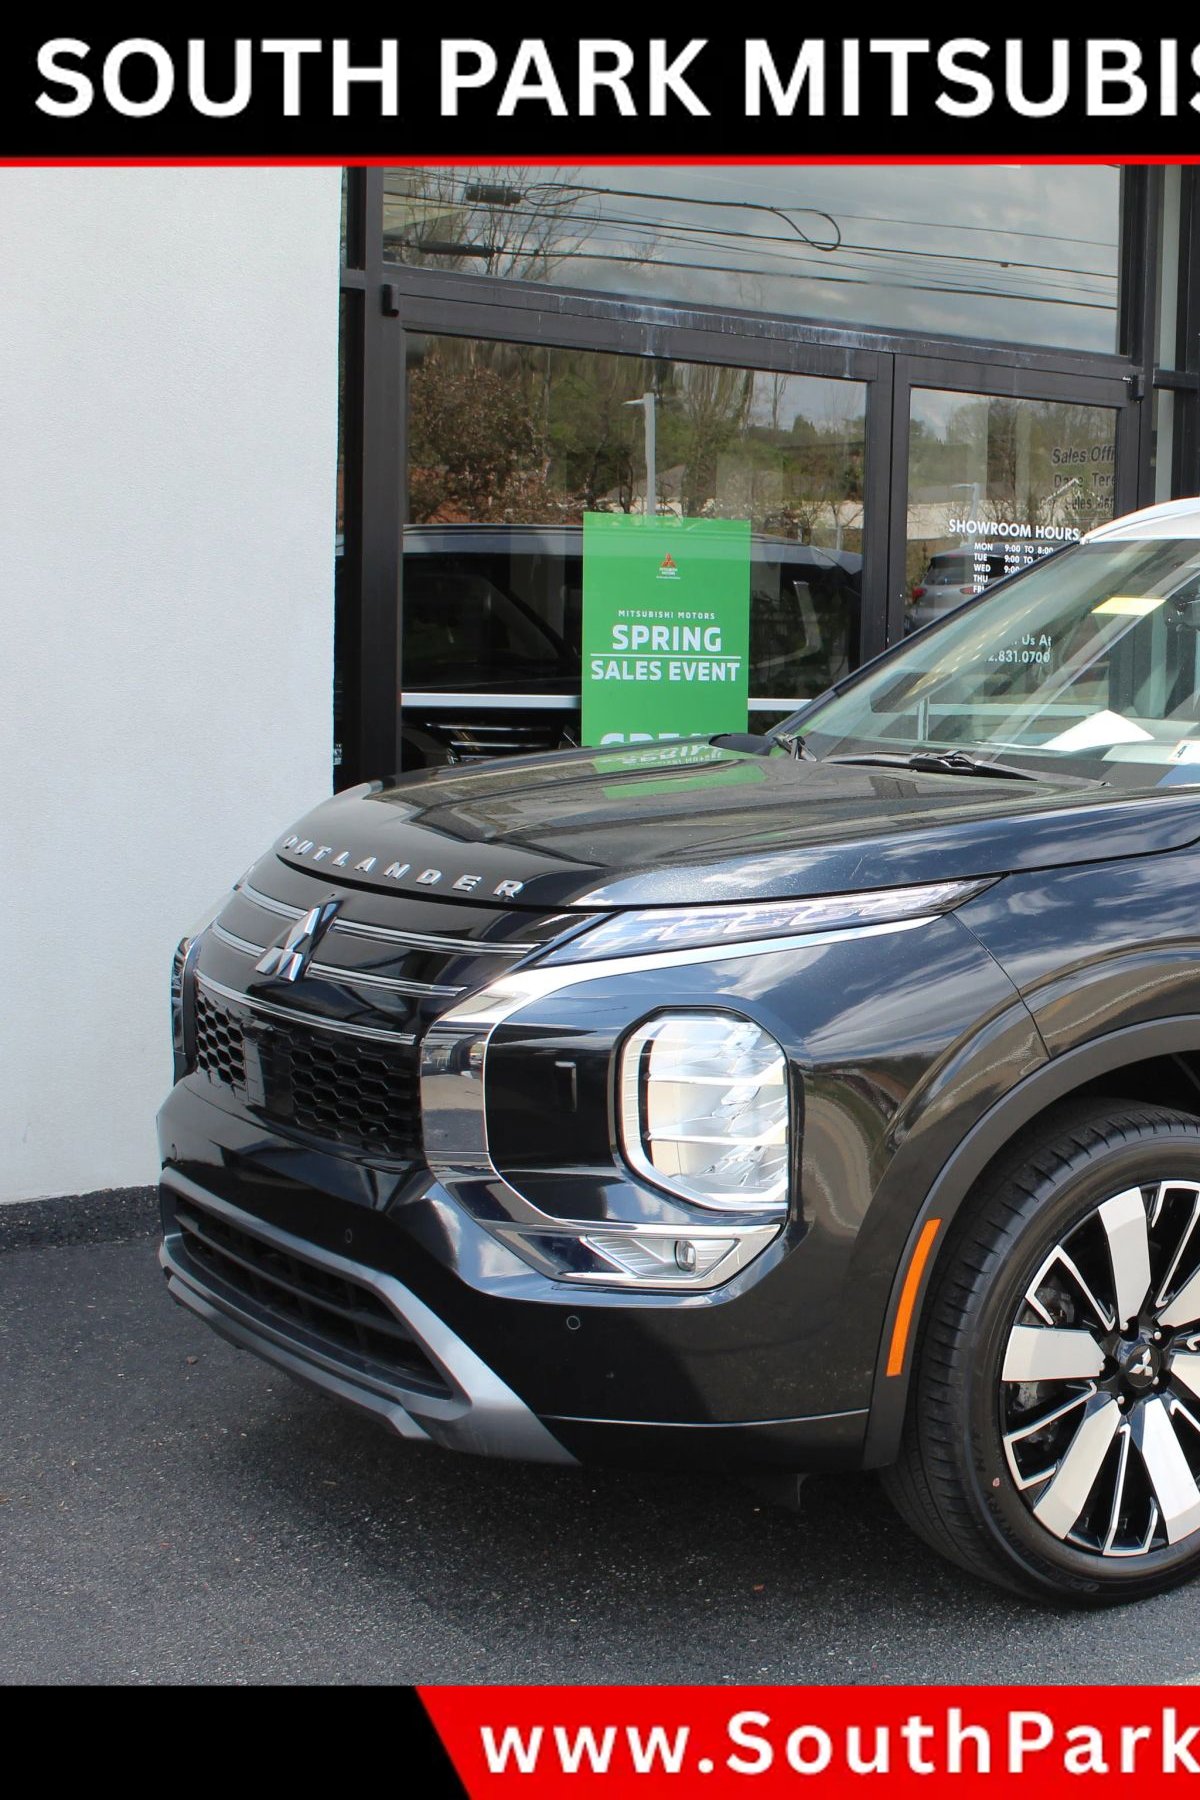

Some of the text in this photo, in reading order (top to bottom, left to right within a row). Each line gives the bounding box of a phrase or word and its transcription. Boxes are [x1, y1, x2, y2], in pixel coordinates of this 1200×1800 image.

[1052, 448, 1087, 464] Sales
[949, 518, 1081, 541] SHOWROOM HOURS
[974, 542, 993, 551] MON
[1004, 544, 1020, 553] 9:00
[1024, 545, 1034, 554] TO
[974, 553, 988, 561] TUE
[1004, 555, 1020, 563] 9:00
[1023, 556, 1034, 564] TO
[974, 564, 991, 572] WED
[973, 574, 989, 583] THU
[618, 609, 715, 620] MITSUBISHI MOTORS
[612, 624, 722, 652] SPRING
[591, 660, 740, 682] SALES EVENT
[282, 833, 525, 899] OUTLANDER
